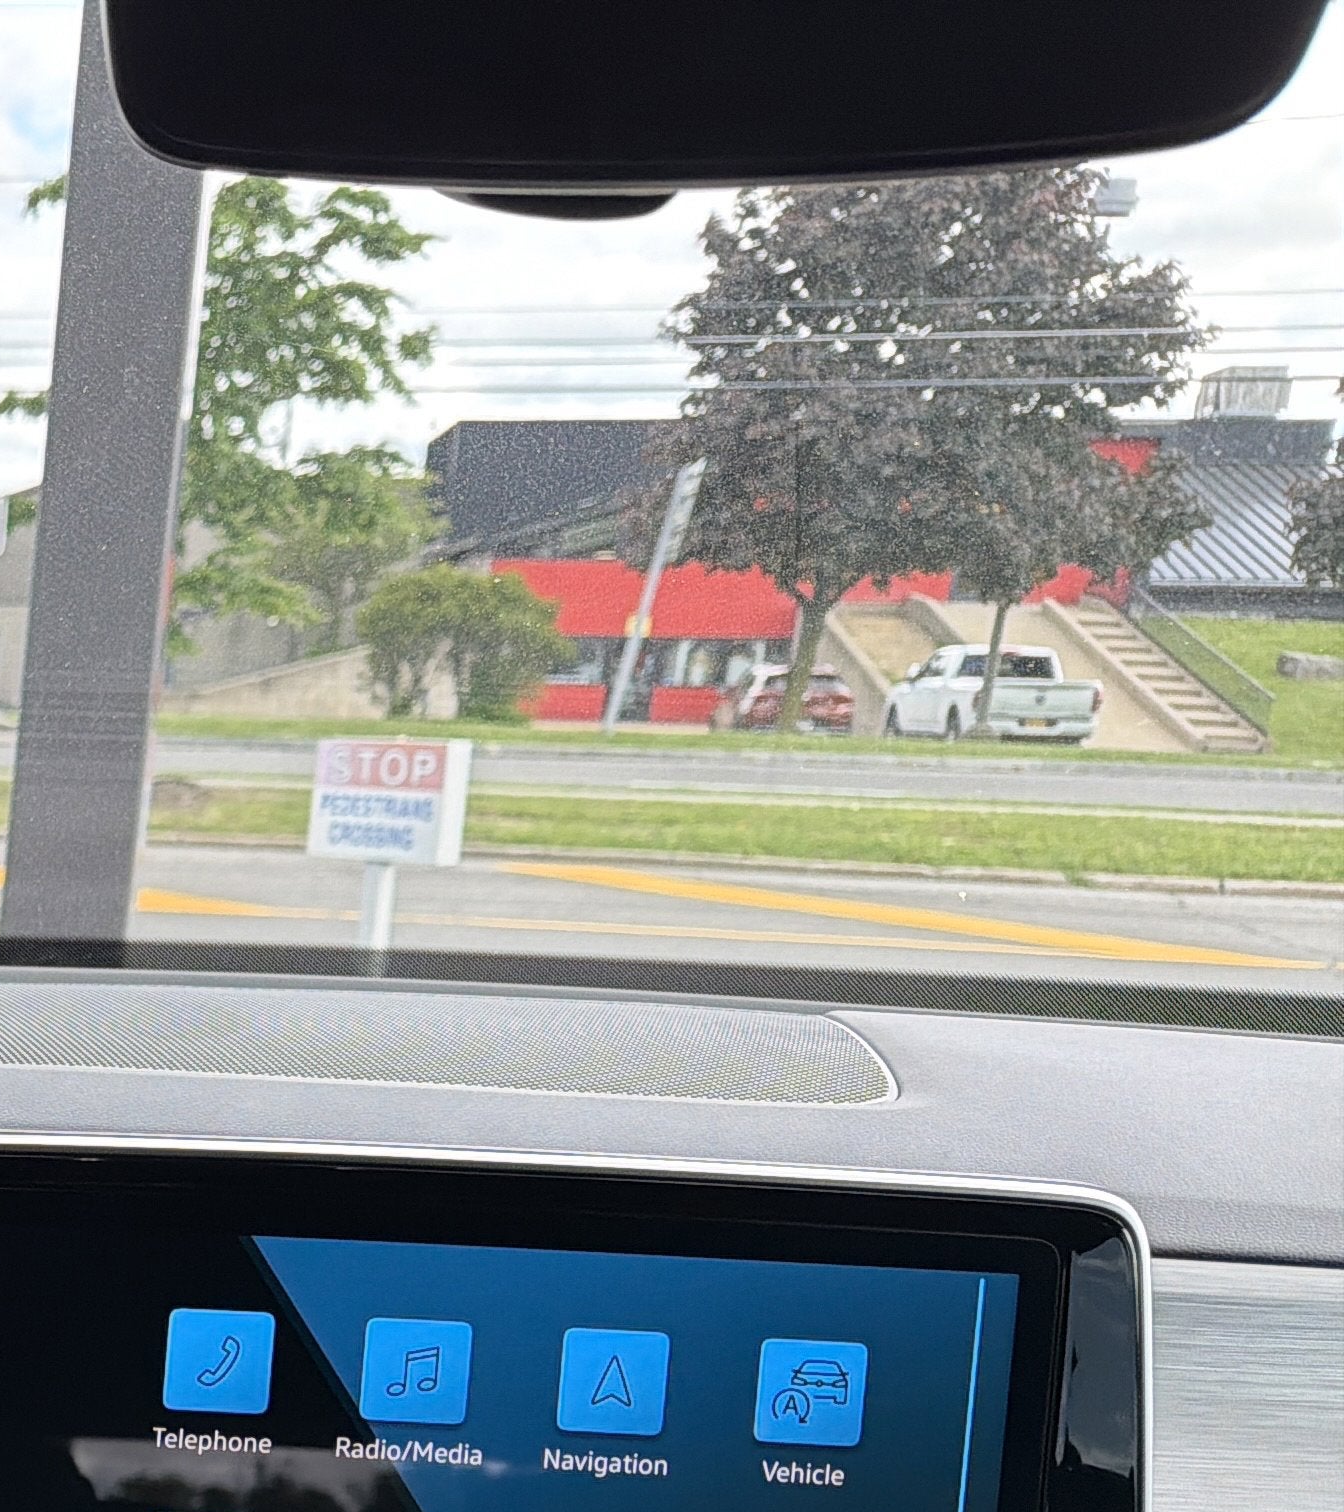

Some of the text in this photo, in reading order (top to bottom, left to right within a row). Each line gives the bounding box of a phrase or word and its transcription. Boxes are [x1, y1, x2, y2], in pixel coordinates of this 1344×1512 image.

[327, 746, 437, 786] STOP
[153, 1427, 273, 1458] Telephone
[336, 1437, 482, 1466] Radio/Media
[544, 1448, 667, 1477] Navigation
[763, 1461, 844, 1485] Vehicle
